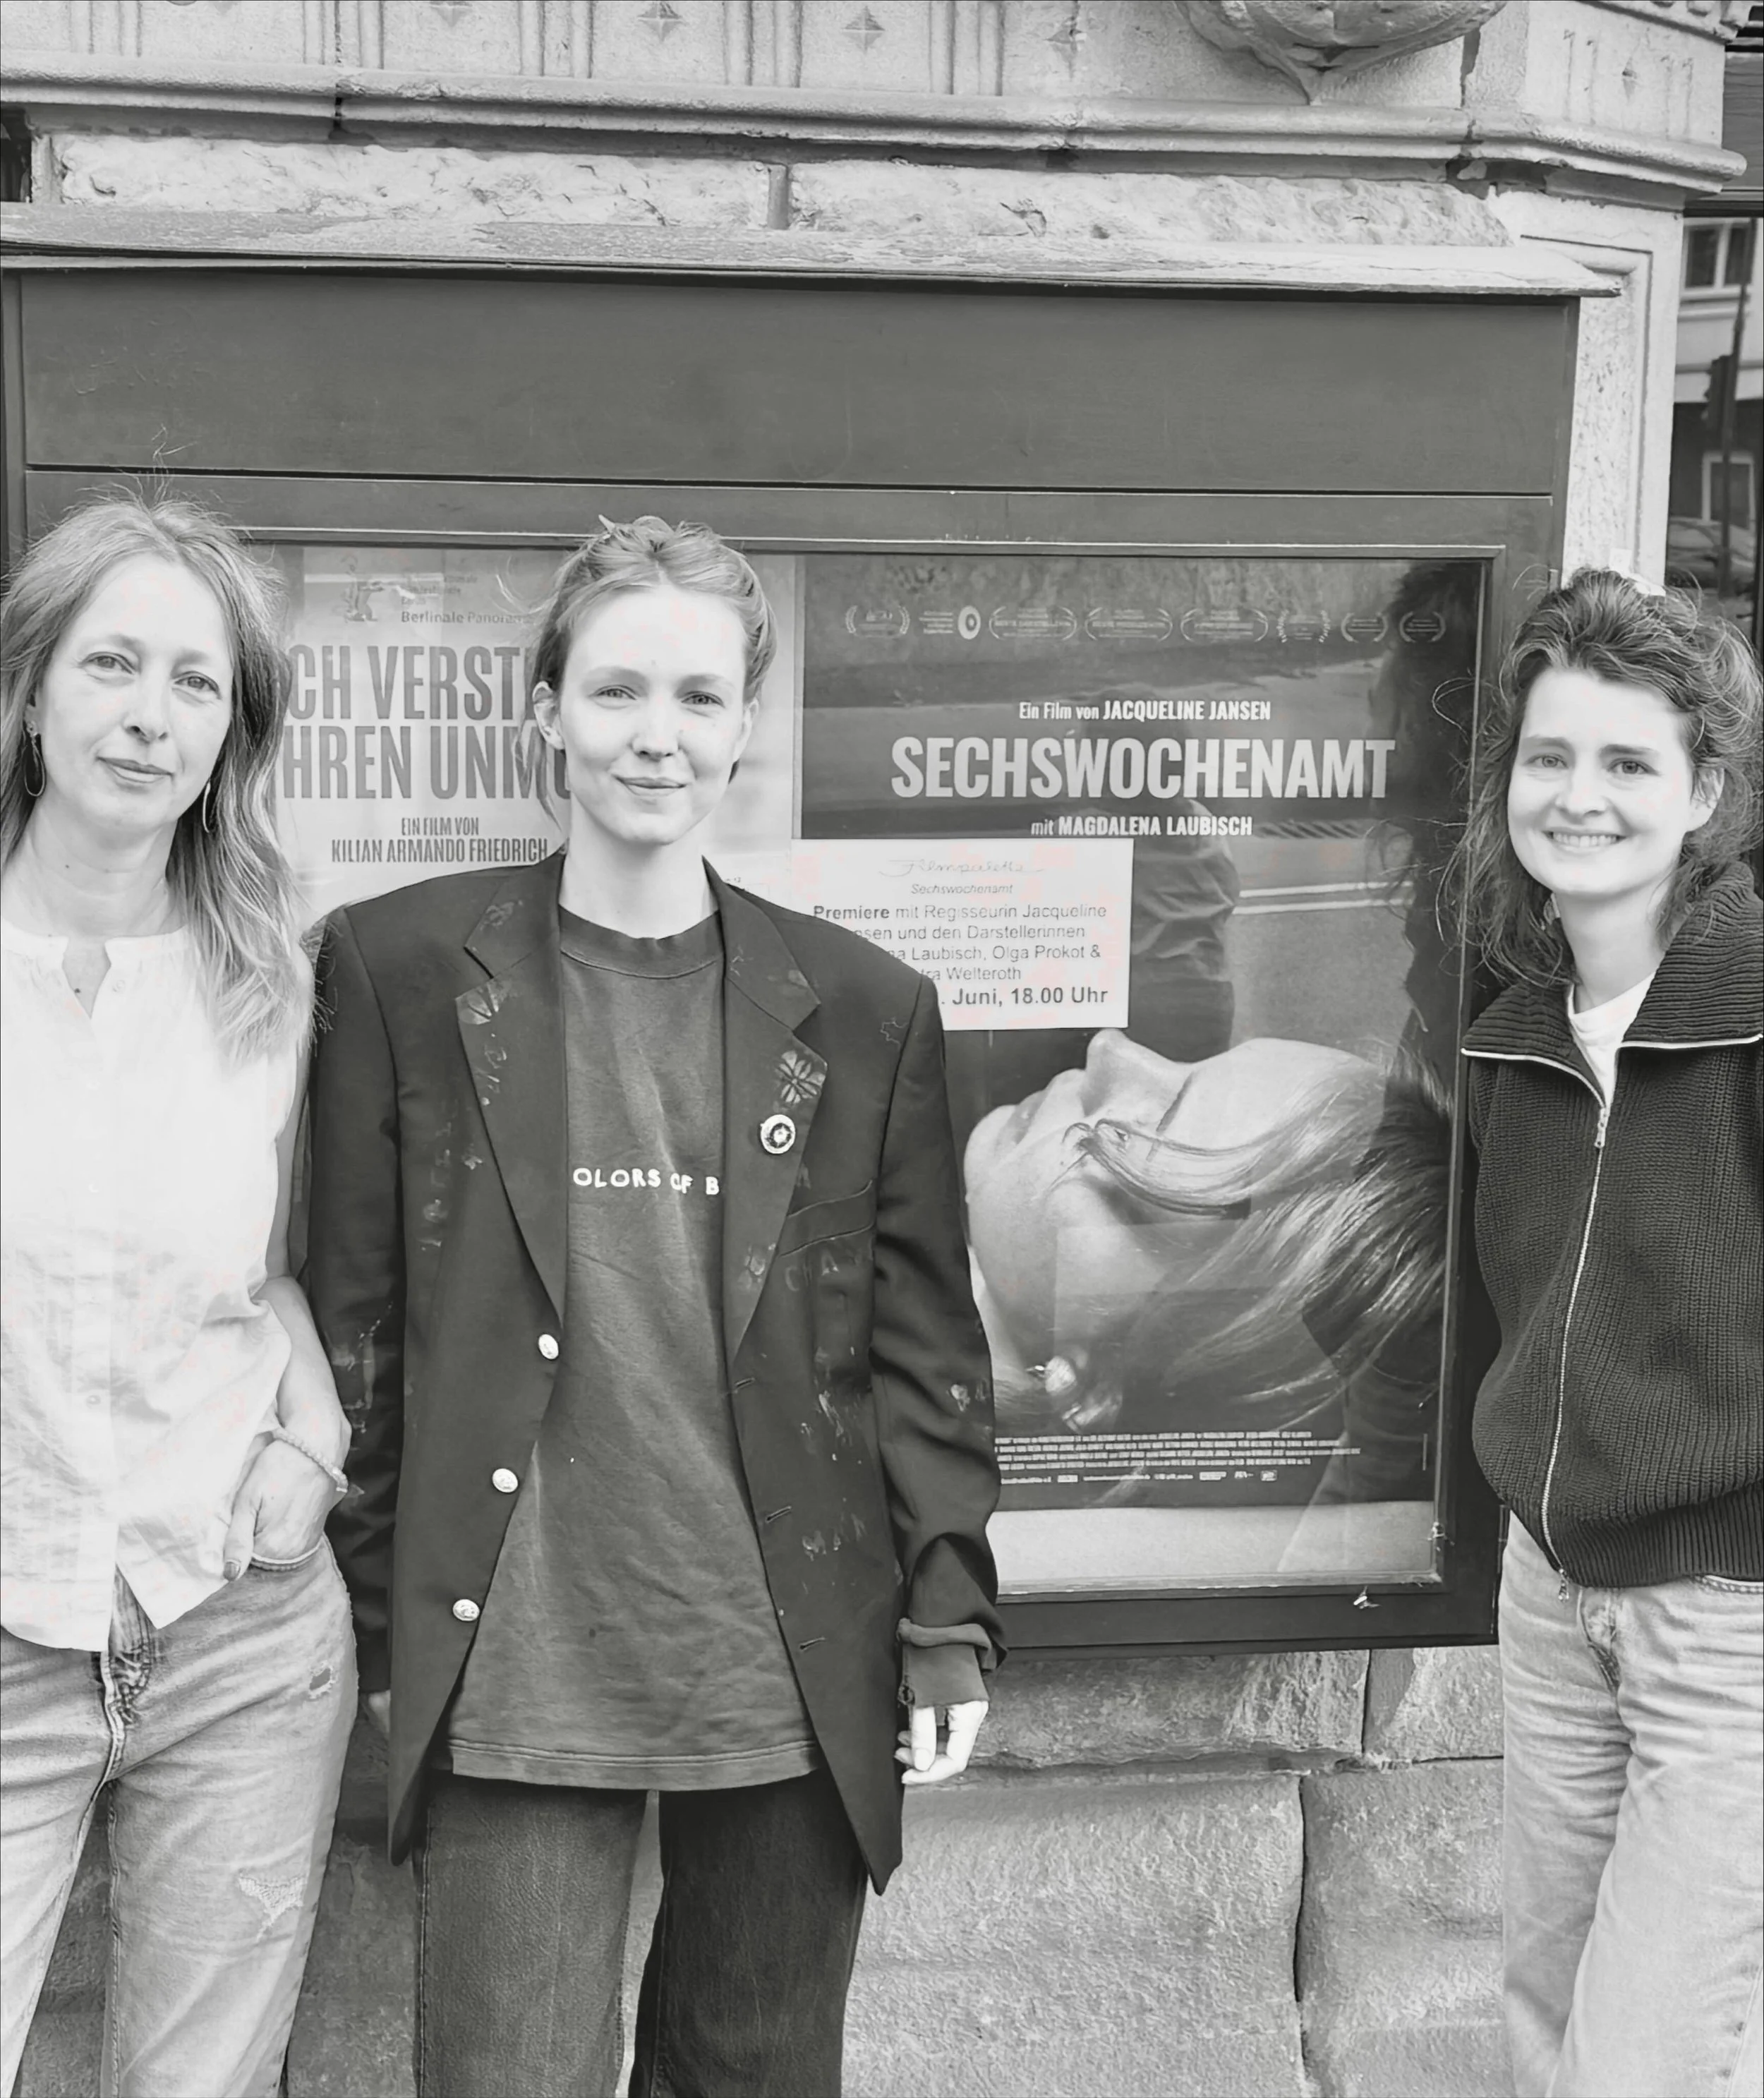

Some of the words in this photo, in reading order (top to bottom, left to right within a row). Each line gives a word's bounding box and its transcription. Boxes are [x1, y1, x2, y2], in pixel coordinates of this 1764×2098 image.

[401, 610, 464, 623] Berlinale
[288, 644, 351, 719] CH
[1020, 702, 1039, 719] Ein
[1044, 702, 1072, 719] Film
[1076, 706, 1099, 719] von
[1103, 701, 1204, 721] JACQUELINE
[1209, 701, 1271, 720] JANSEN
[284, 725, 411, 799] HREN
[890, 737, 1396, 800] SECHSWOCHENAMT
[401, 817, 420, 836] EIN
[423, 817, 452, 836] FILM
[455, 817, 479, 835] VON
[1031, 819, 1053, 836] mit
[1058, 816, 1161, 836] MAGDALENA
[1166, 816, 1252, 836] LAUBISCH
[332, 840, 382, 862] KILIAN
[387, 840, 465, 862] ARMANDO
[469, 838, 548, 862] FRIEDRICH
[911, 884, 1013, 895] Sechswochenamt
[814, 905, 890, 920] Premiere
[895, 906, 919, 918] mit
[924, 904, 1017, 922] Regisseurin
[1022, 904, 1106, 920] Jacqueline
[898, 927, 926, 939] und
[932, 926, 961, 939] den
[967, 925, 1085, 939] Darstellerinnen
[912, 946, 986, 960] Laubisch,
[992, 945, 1029, 962] Olga
[1034, 944, 1085, 958] Prokot
[1089, 944, 1101, 958] &
[946, 965, 1021, 979] Welteroth
[952, 988, 1003, 1006] Juni,
[1010, 987, 1063, 1004] 18.00
[1071, 987, 1108, 1003] Uhr
[572, 1167, 661, 1188] OLORS
[706, 1176, 720, 1195] B
